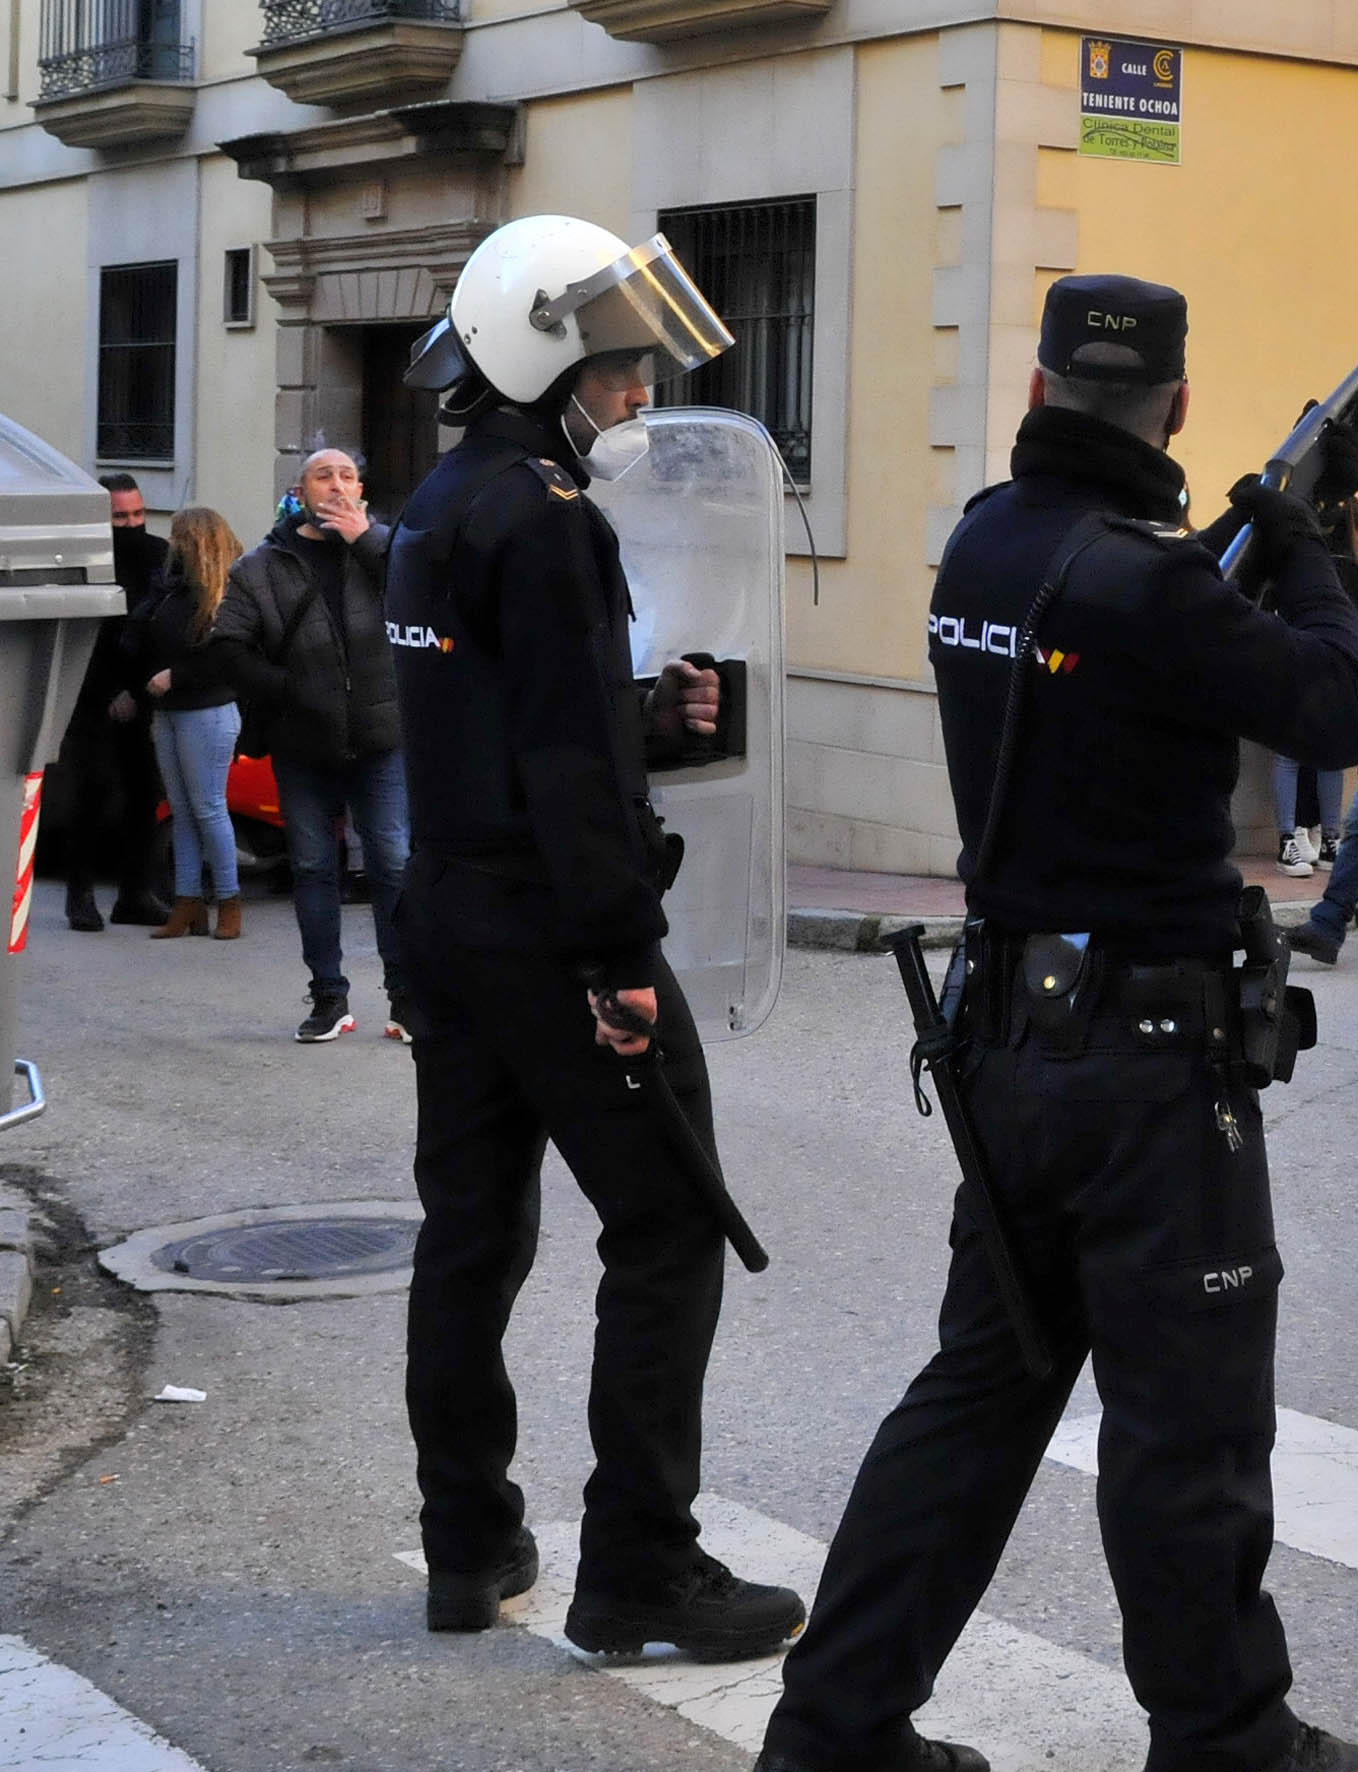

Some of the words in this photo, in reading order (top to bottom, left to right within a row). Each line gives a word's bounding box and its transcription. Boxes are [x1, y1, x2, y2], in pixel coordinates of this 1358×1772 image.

[1121, 63, 1147, 76] CALLE
[1083, 92, 1136, 111] TENIENTE
[1140, 99, 1178, 115] OCHOA
[1134, 123, 1175, 136] Dental
[1088, 310, 1137, 331] CNP
[1204, 1266, 1253, 1293] CNP
